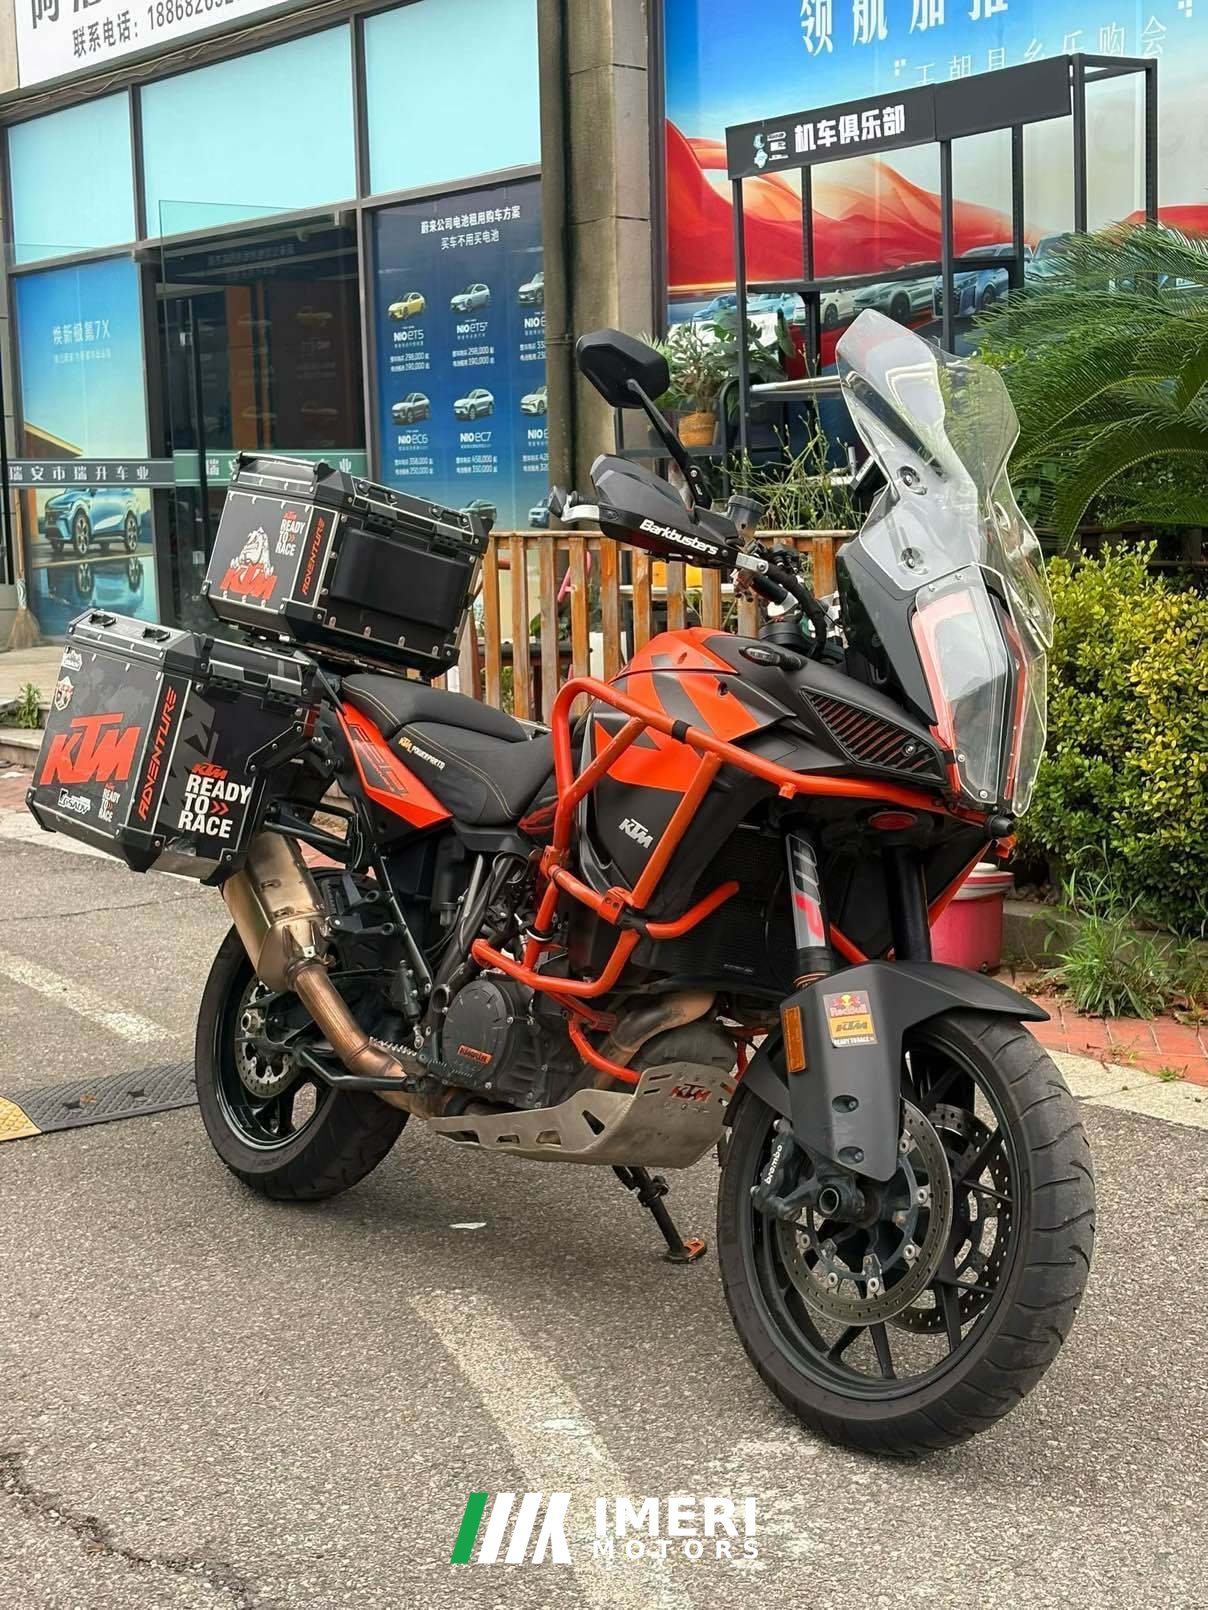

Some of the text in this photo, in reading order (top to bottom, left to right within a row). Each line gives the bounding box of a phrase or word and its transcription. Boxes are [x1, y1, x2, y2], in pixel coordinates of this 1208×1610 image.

[794, 104, 905, 153] 机车俱乐部
[441, 229, 500, 250] 买车不用买电池
[8, 465, 150, 482] 瑞安市瑞升车业
[278, 530, 290, 546] TO
[280, 518, 307, 536] READY
[639, 517, 720, 556] Barkbusters
[275, 542, 297, 557] RACE
[300, 515, 326, 597] ADVENTURE
[39, 711, 142, 786] KTM
[137, 685, 178, 823] ADVENTURE
[190, 762, 229, 781] KTM
[102, 787, 121, 804] READY
[186, 773, 252, 805] READY
[184, 793, 210, 822] TO
[177, 810, 234, 839] RACE
[618, 817, 654, 849] KTM
[835, 1020, 868, 1033] KTM
[671, 1083, 713, 1104] KTM
[764, 1144, 784, 1185] brembo
